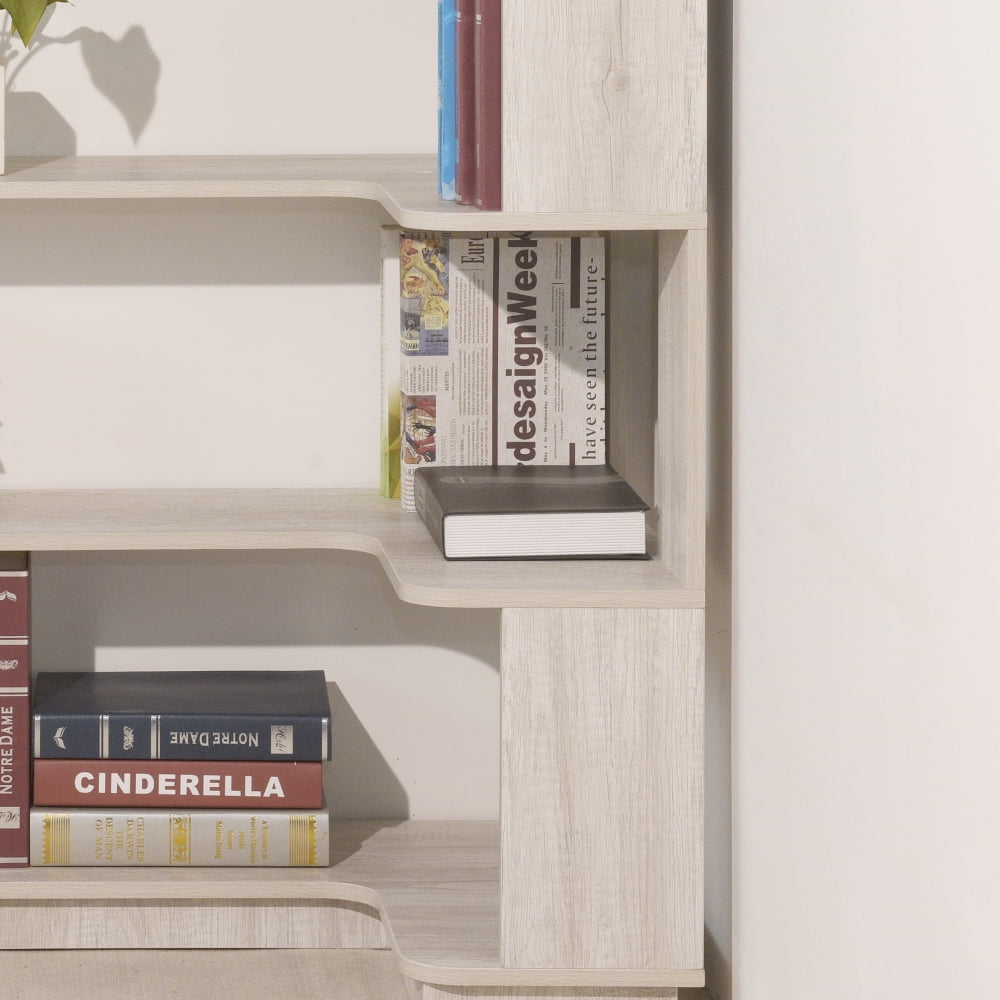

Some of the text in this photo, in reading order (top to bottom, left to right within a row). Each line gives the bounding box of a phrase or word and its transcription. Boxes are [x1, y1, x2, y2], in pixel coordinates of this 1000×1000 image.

[582, 257, 599, 460] have seen the future-
[170, 731, 259, 747] NOTRE DAME
[73, 771, 285, 798] CINDERELLA
[95, 836, 103, 860] MAN
[126, 819, 135, 860] DARWIN
[136, 817, 145, 862] CHARLES
